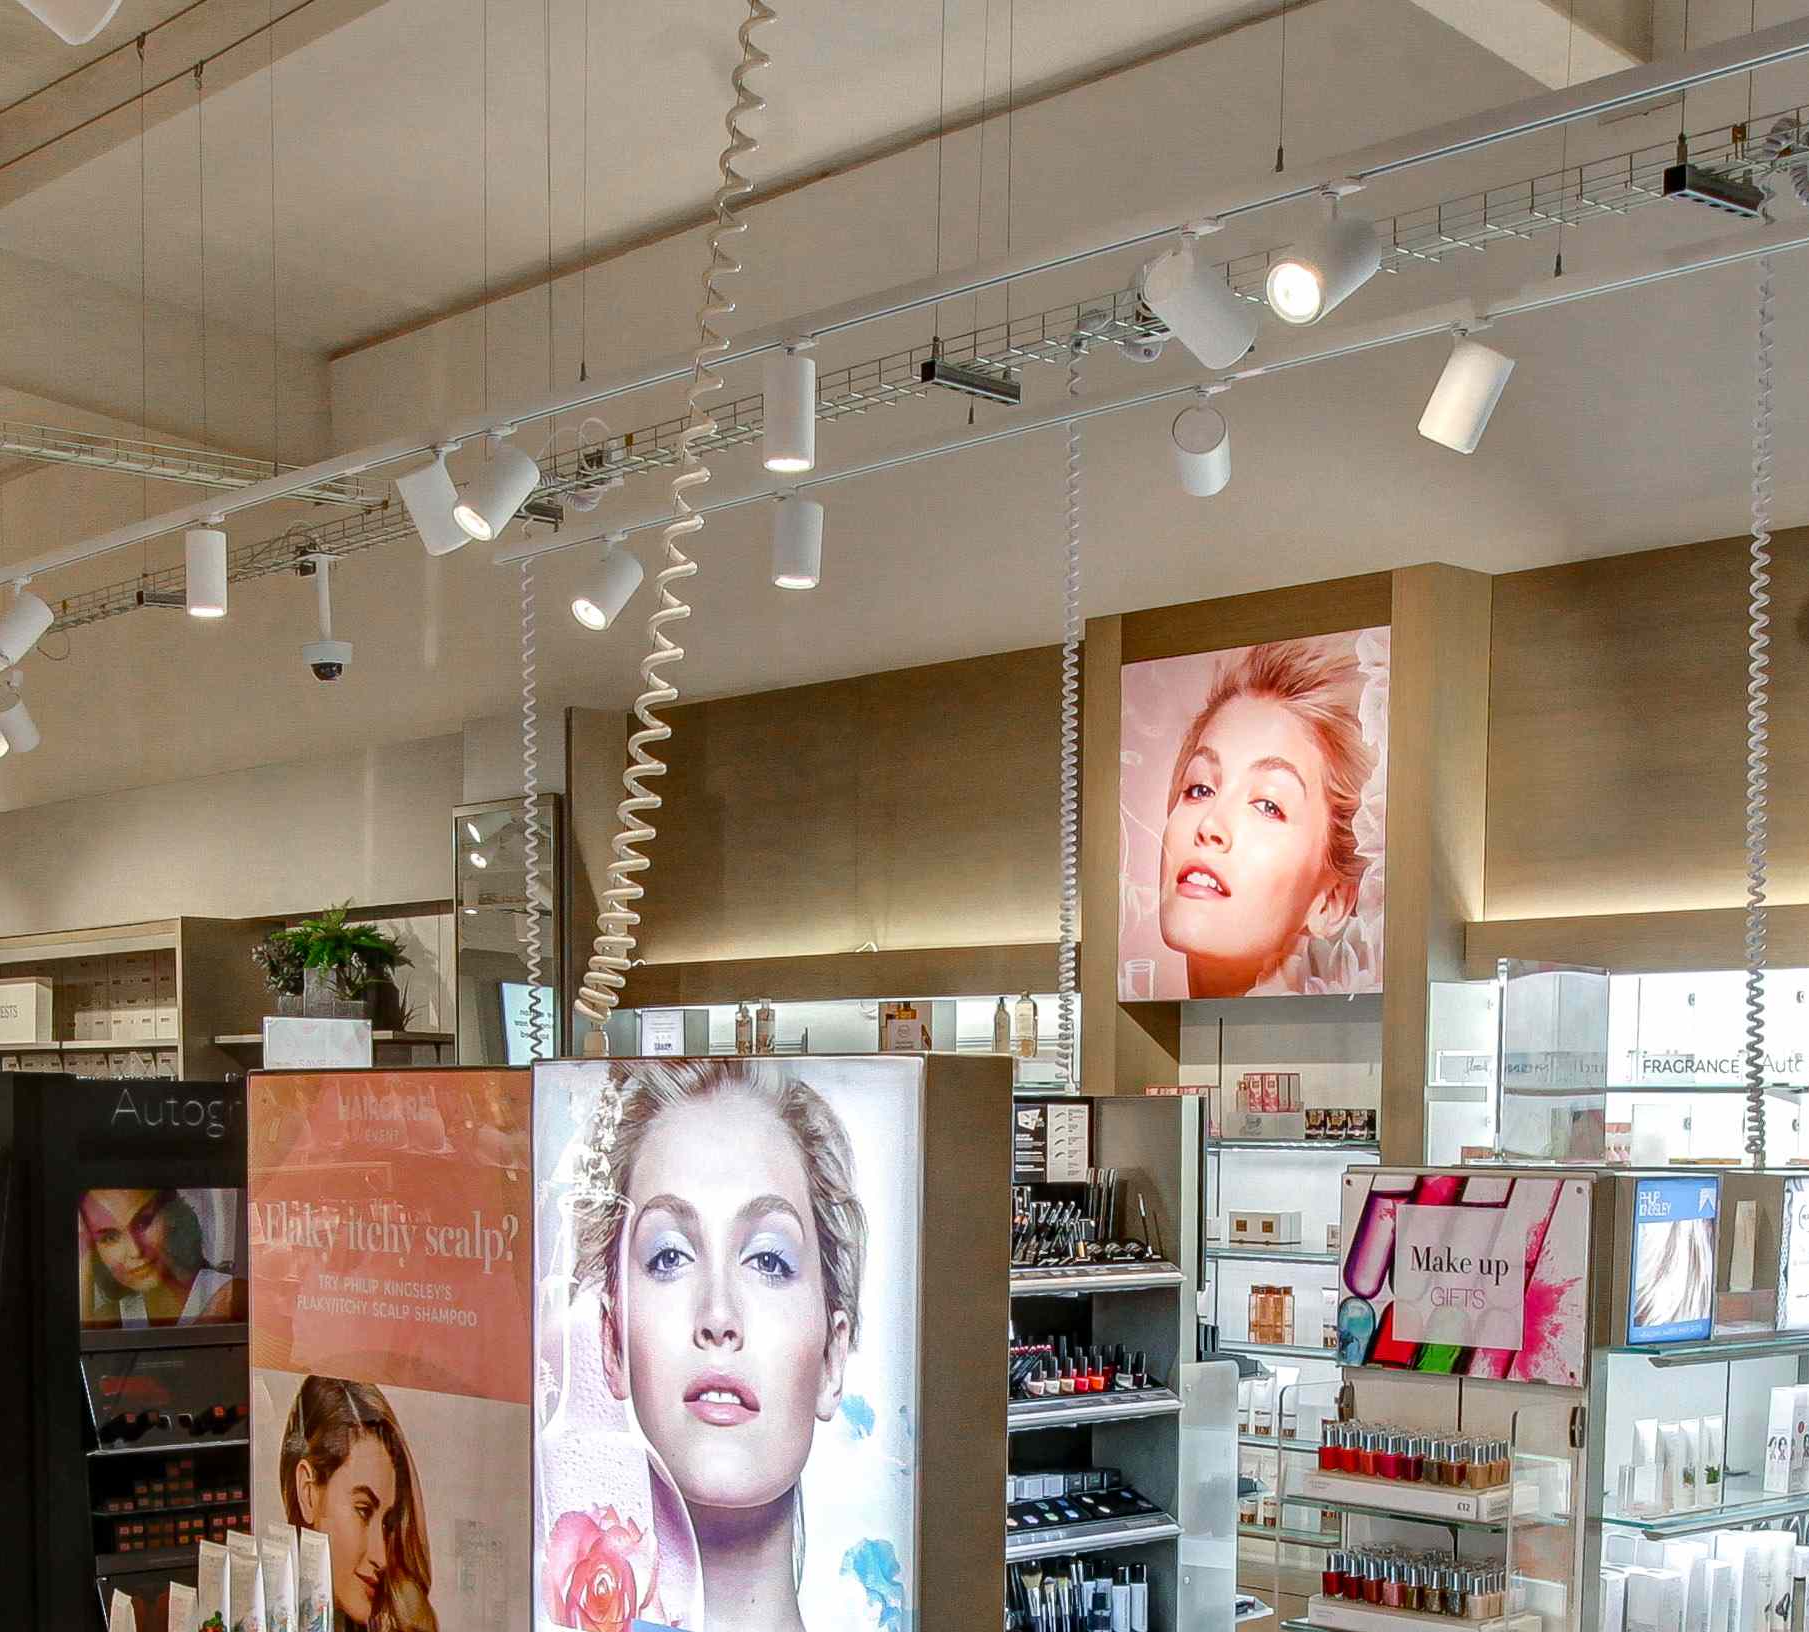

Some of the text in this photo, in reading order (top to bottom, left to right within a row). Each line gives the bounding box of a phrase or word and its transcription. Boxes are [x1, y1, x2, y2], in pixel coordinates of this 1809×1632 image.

[1642, 1058, 1740, 1075] FRAGRANCE
[266, 1201, 520, 1275] Flaky itchy scalp?
[1410, 1245, 1510, 1286] Make up
[318, 1275, 452, 1301] TRY PHILIP KINGSLEY'S
[1430, 1286, 1487, 1310] GIFTS
[372, 1302, 411, 1321] SCALP
[415, 1307, 479, 1328] SHAMPOO
